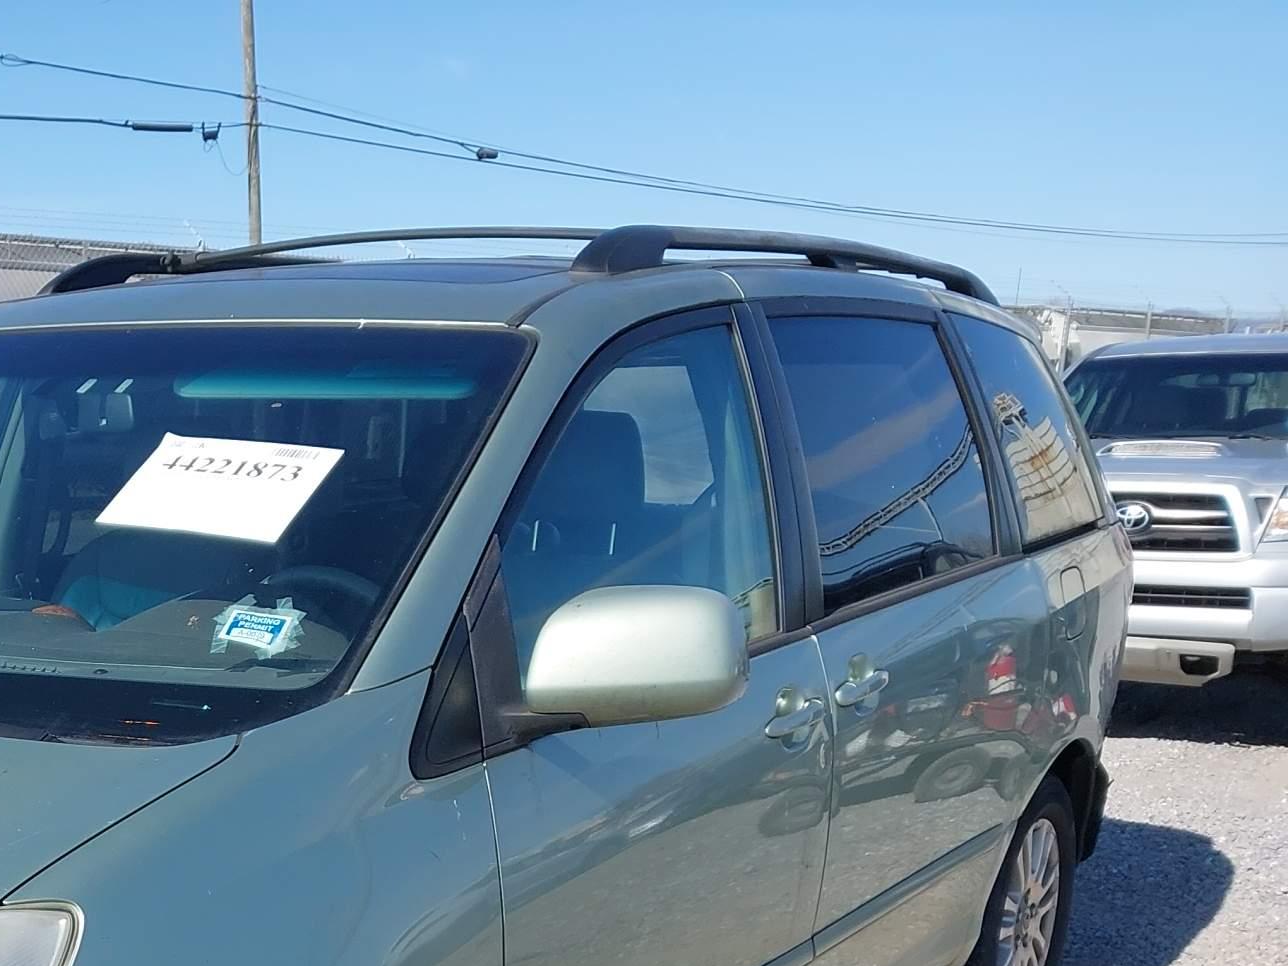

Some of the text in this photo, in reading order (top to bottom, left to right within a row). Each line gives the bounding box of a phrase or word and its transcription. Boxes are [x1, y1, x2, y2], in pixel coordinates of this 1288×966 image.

[162, 455, 303, 481] 44221873
[237, 620, 275, 632] PERMIT
[238, 613, 281, 626] PARKING
